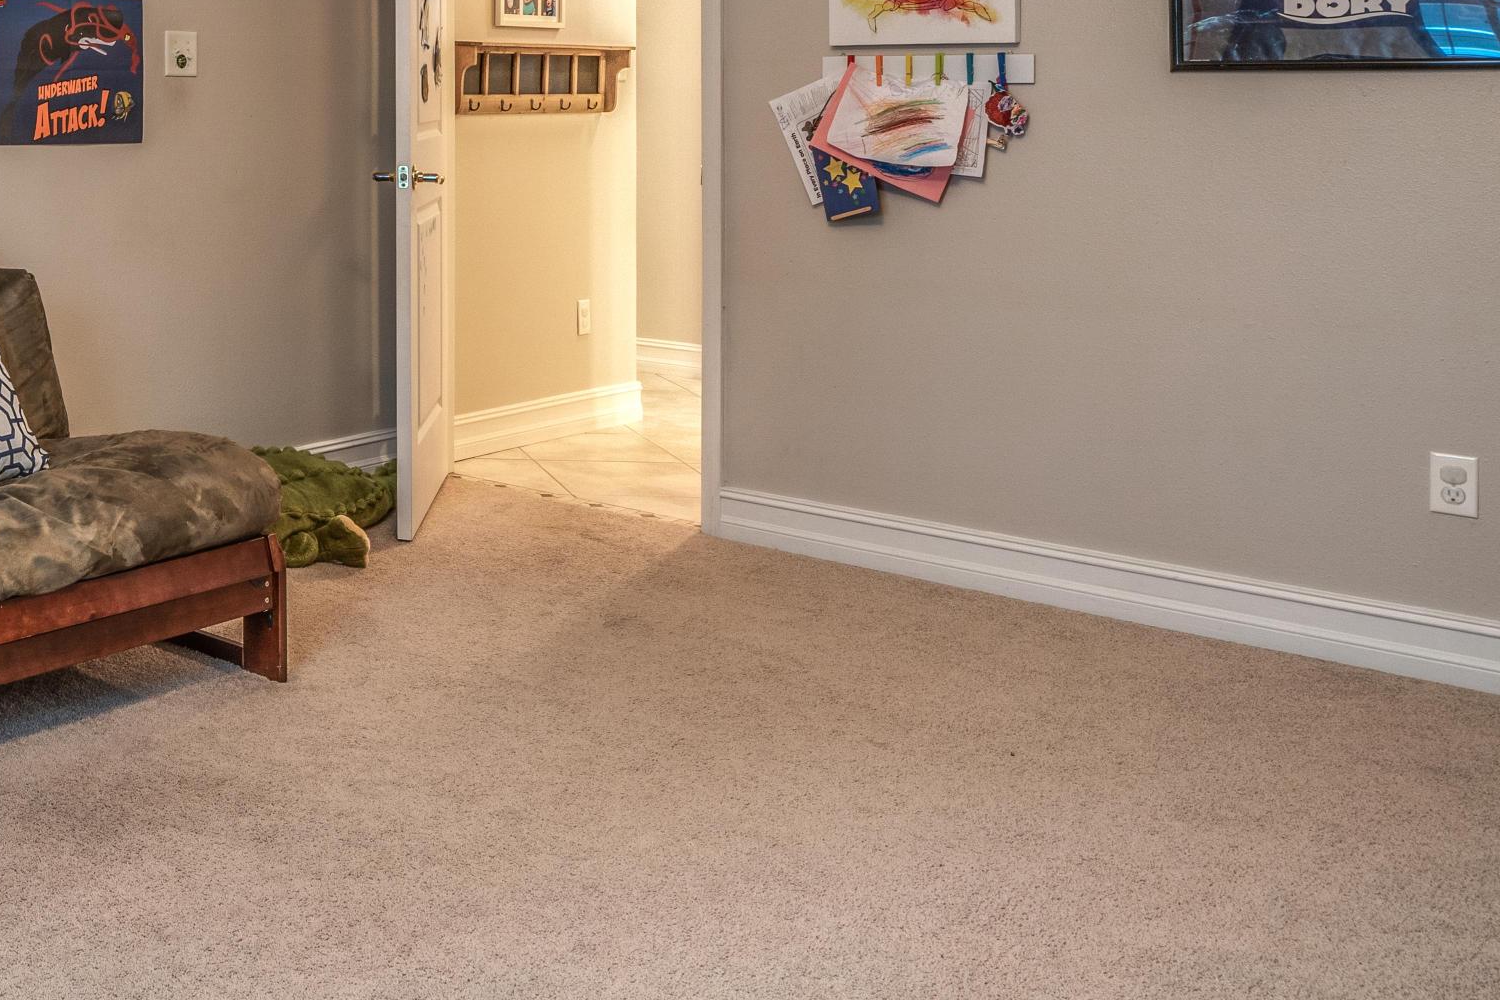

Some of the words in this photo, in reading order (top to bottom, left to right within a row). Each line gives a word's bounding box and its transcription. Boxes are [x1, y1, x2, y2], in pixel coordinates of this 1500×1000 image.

[38, 75, 98, 100] UNDERWATER
[791, 132, 801, 149] Earth
[798, 149, 805, 158] on
[802, 158, 812, 175] Place
[809, 174, 819, 191] Every
[816, 191, 822, 199] In
